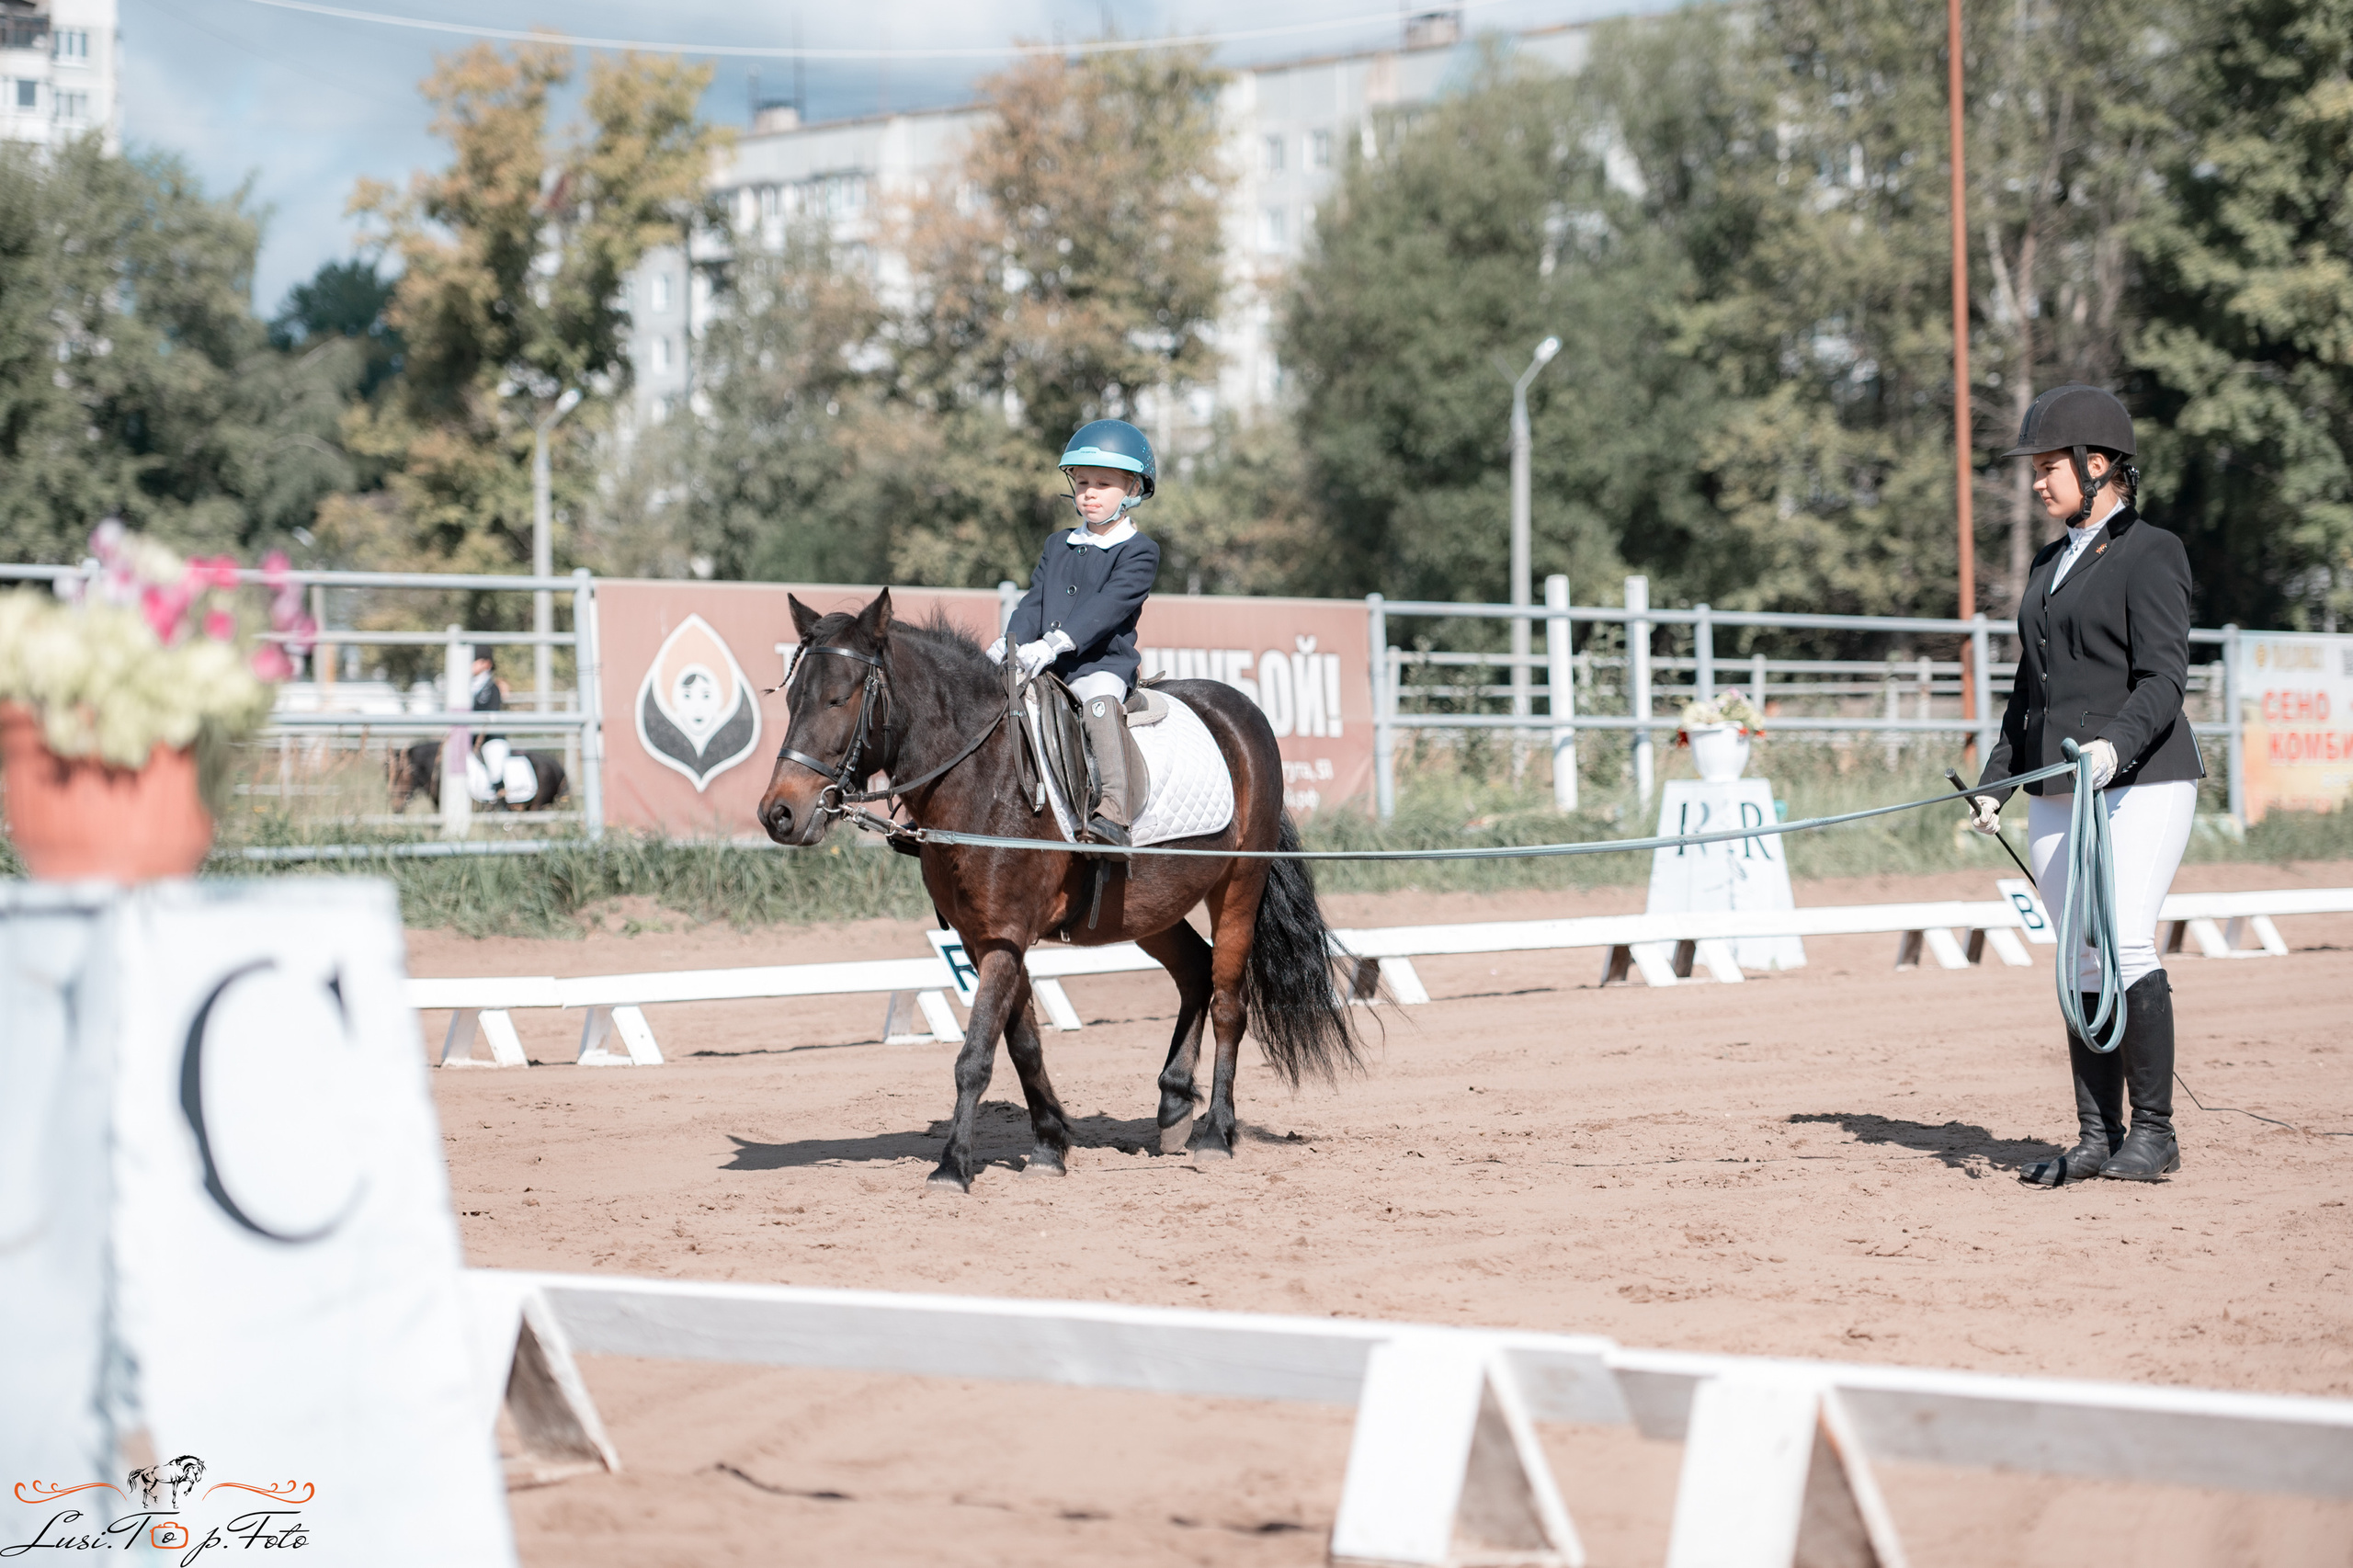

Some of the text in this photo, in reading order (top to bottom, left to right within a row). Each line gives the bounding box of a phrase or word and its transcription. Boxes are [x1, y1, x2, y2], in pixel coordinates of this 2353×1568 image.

[2262, 689, 2330, 722] СЕНО
[1740, 801, 1772, 860] R
[2010, 892, 2045, 930] B
[178, 953, 371, 1246] C
